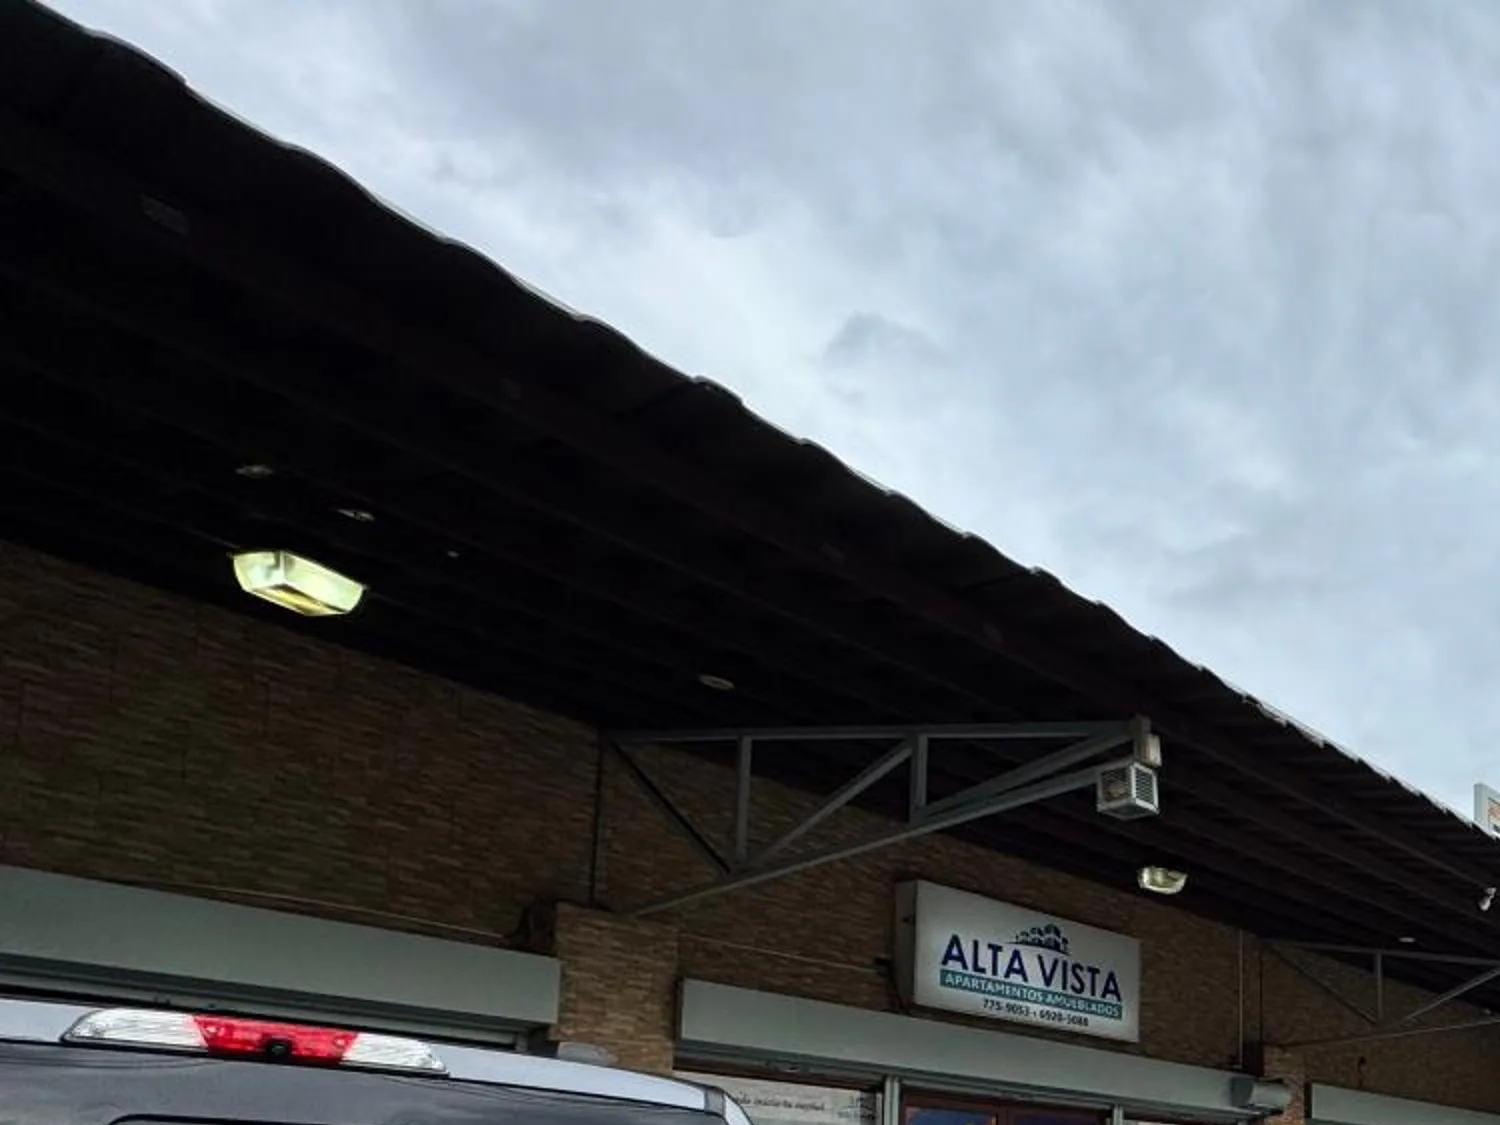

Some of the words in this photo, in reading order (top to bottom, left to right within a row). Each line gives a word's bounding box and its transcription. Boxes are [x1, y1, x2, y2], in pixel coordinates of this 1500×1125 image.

[941, 934, 1028, 982] ALTA
[1037, 954, 1121, 1002] VISTA
[945, 975, 1043, 1002] APARTAMENTOS
[1046, 991, 1119, 1017] AMUEBLADOS
